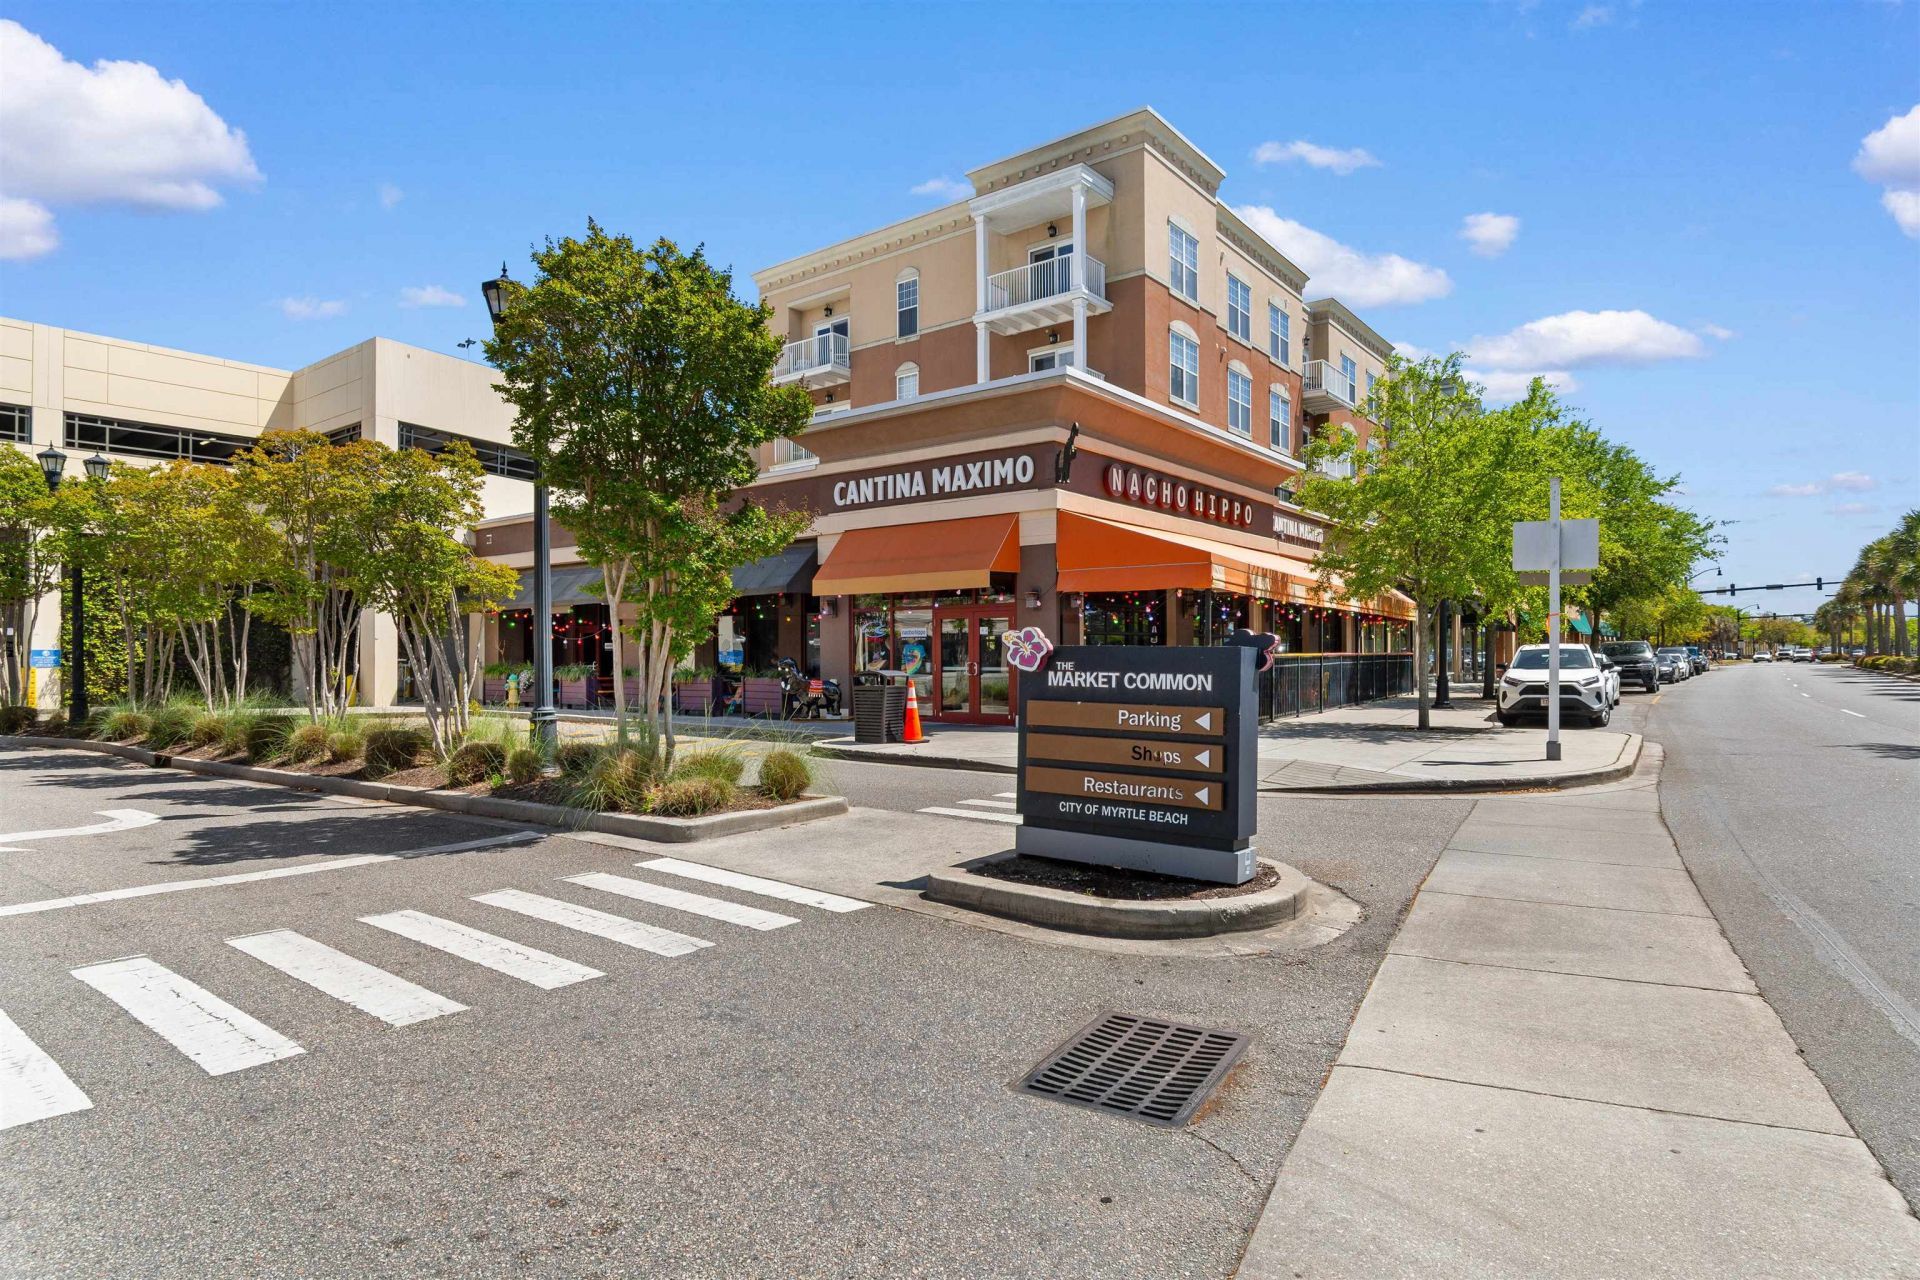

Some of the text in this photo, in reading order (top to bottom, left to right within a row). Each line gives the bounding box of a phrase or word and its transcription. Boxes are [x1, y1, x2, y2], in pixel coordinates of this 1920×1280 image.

[833, 455, 1035, 506] CANTINA MAXIMO
[1112, 467, 1253, 524] NACHO HIPPO
[1273, 514, 1299, 537] ANTINA
[1056, 661, 1075, 671] THE
[1048, 671, 1212, 691] MARKET COMMON
[1118, 709, 1182, 731] Parking
[1084, 777, 1184, 800] Restaurants
[1059, 801, 1188, 825] CITY OF MYRTLE BEACH
